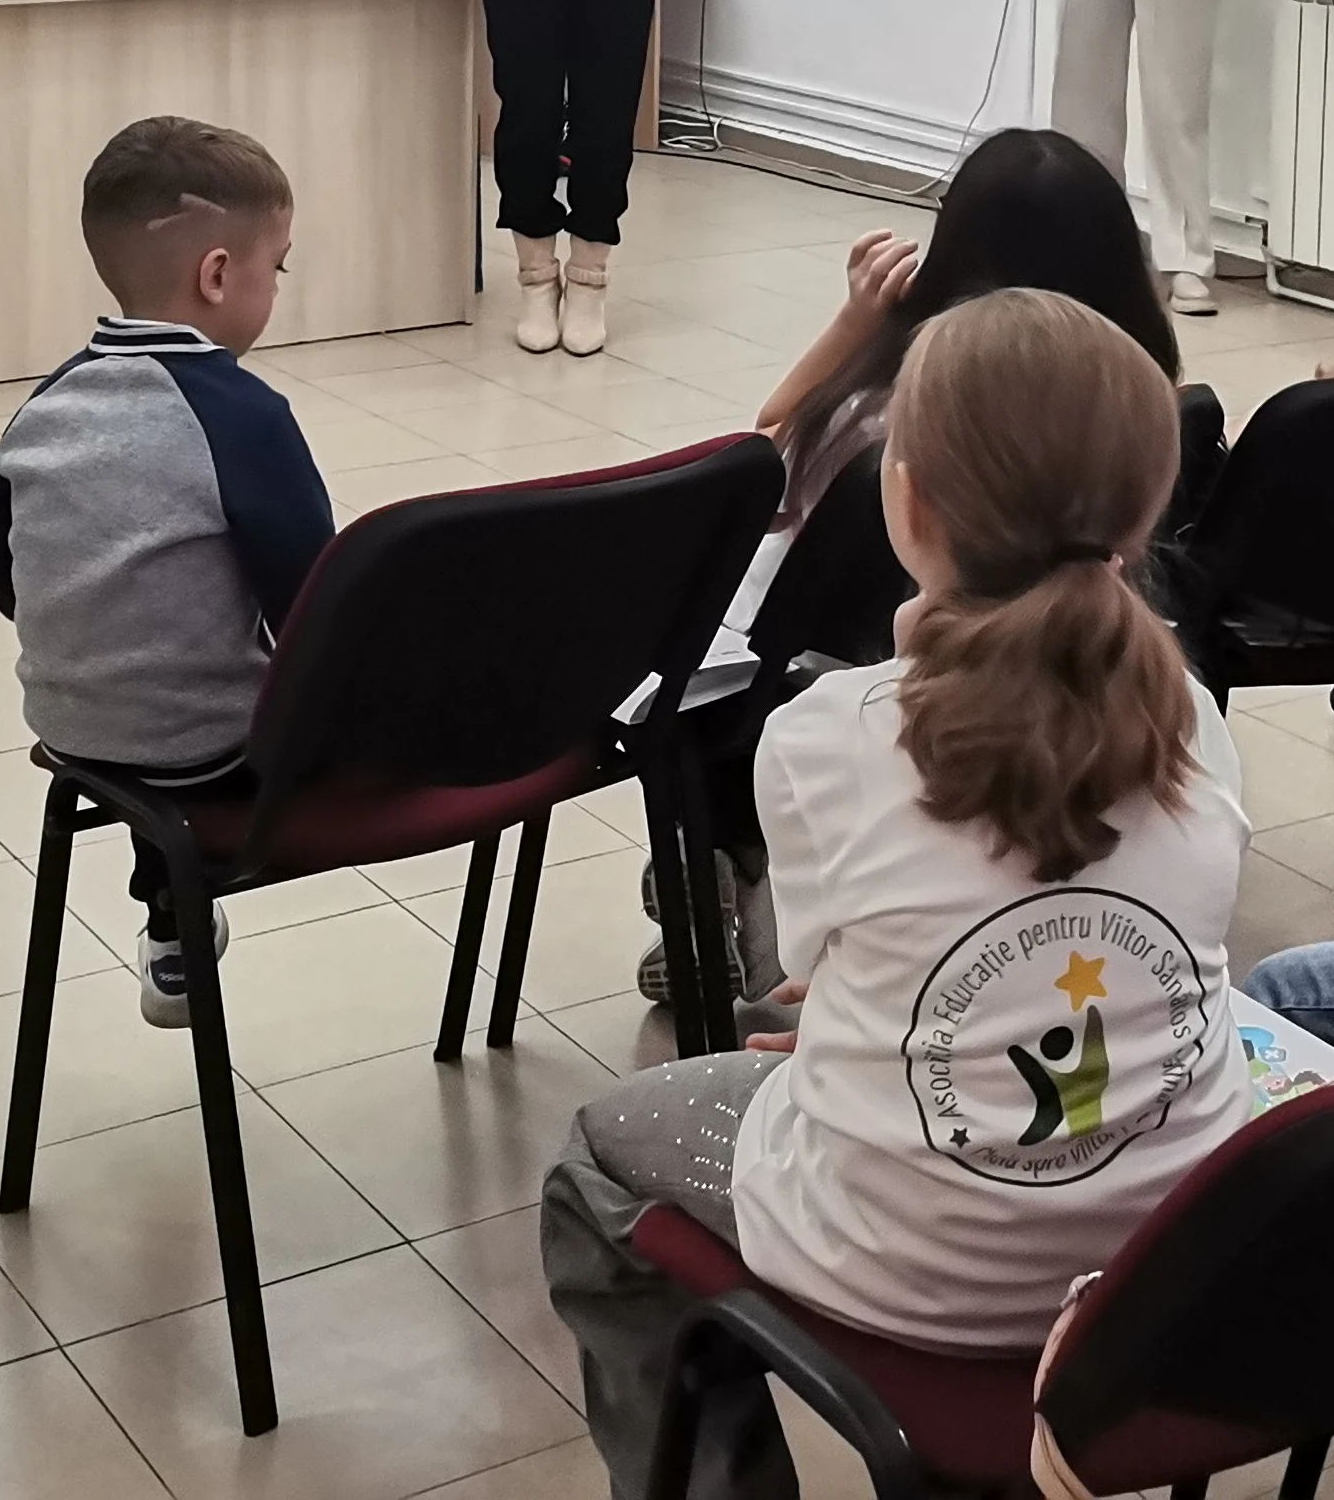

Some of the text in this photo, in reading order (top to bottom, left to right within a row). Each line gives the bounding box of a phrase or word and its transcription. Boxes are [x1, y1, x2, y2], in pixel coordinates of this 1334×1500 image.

[933, 940, 1015, 1025] Educație
[1017, 911, 1092, 961] pentru
[1100, 909, 1158, 961] Viitor
